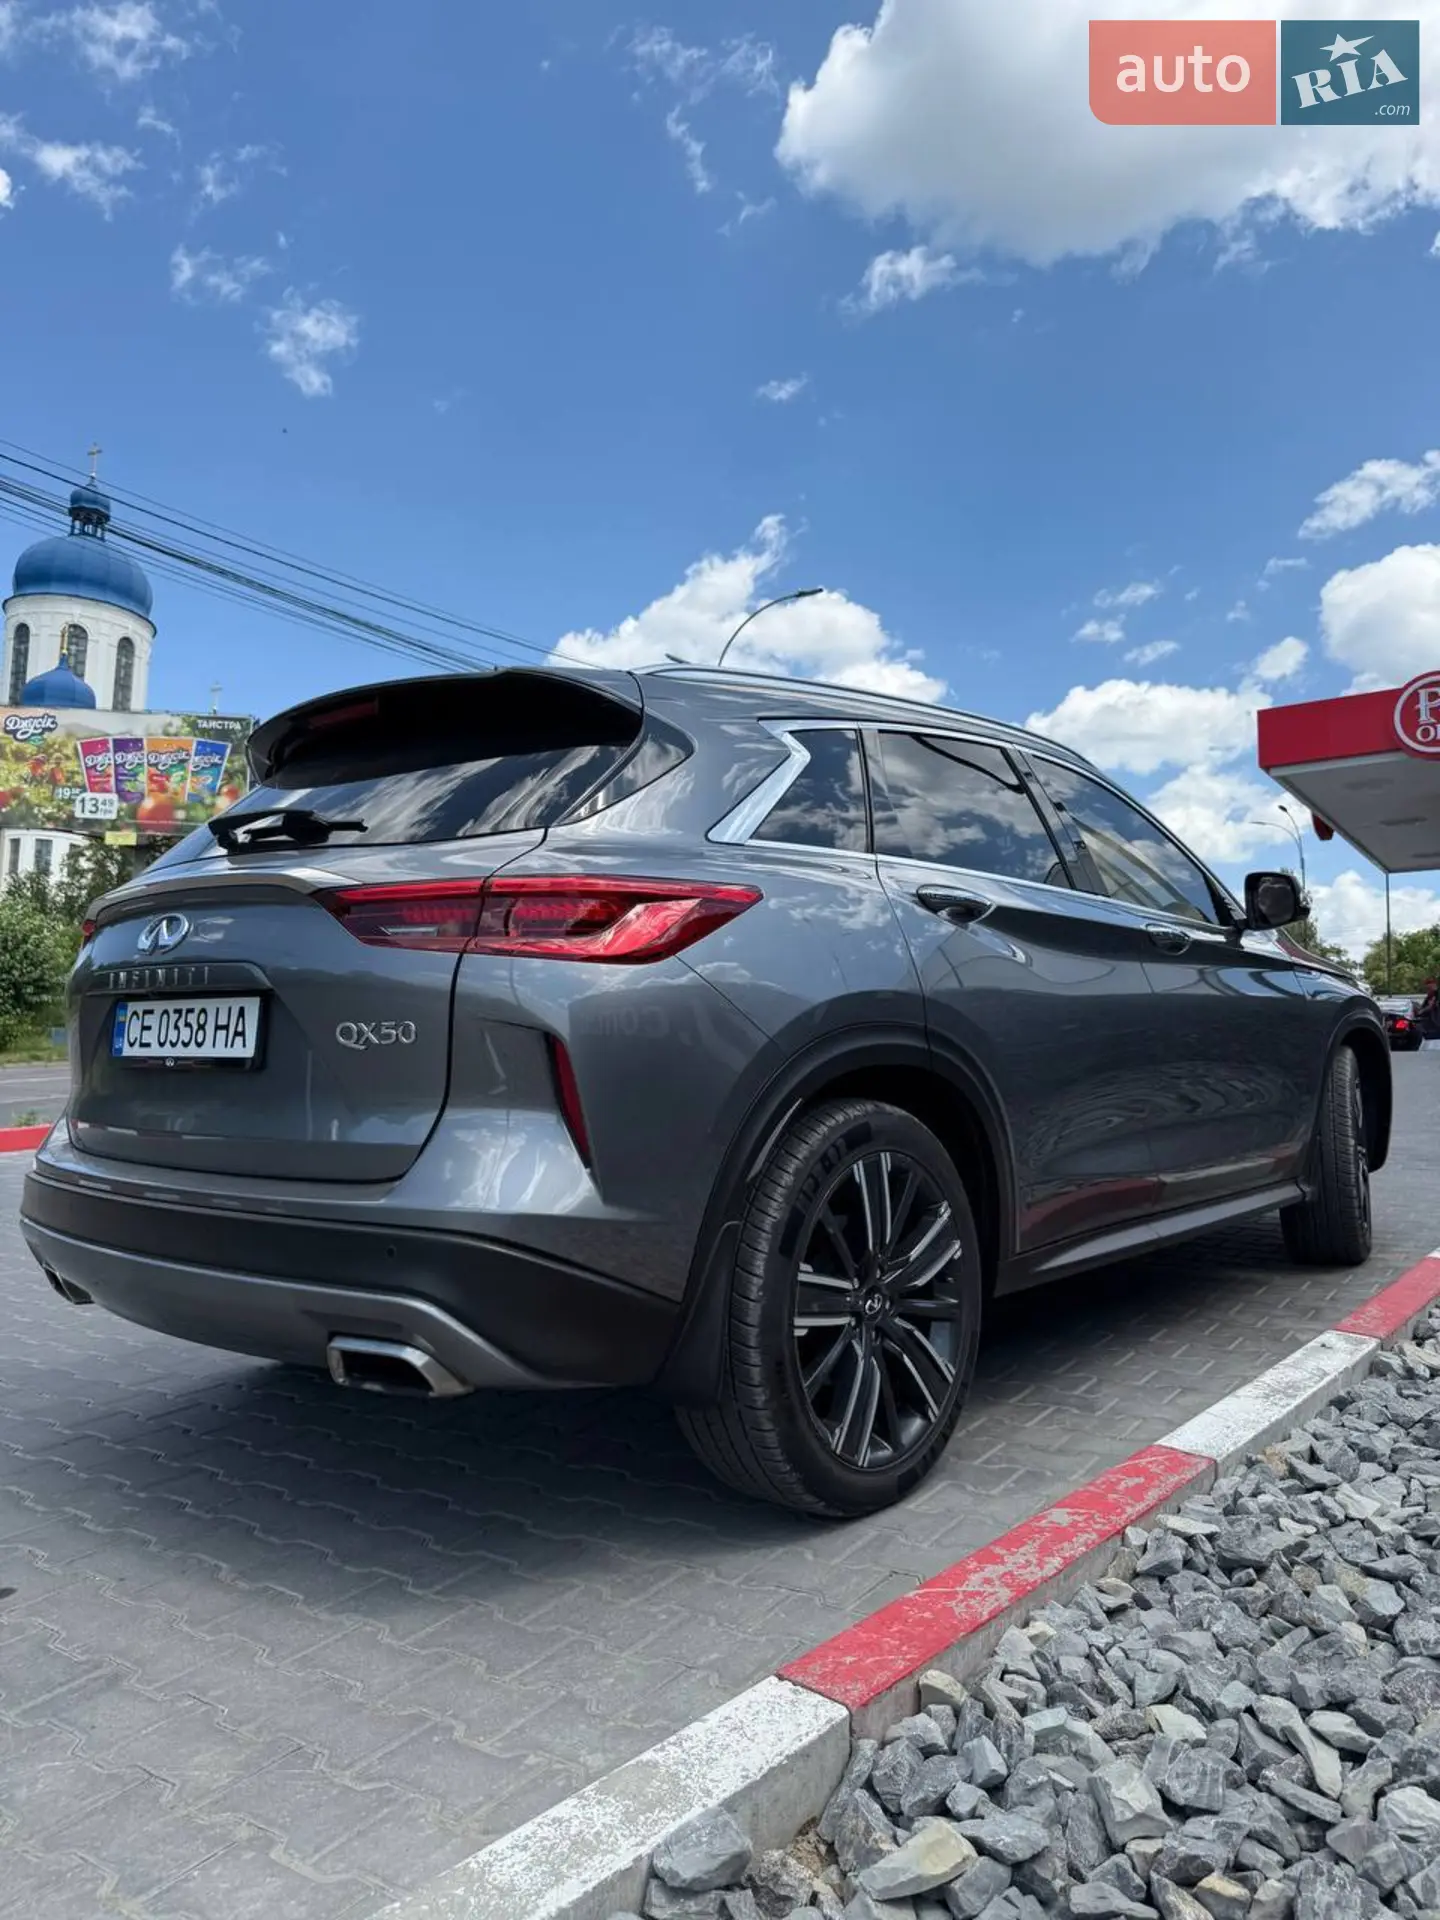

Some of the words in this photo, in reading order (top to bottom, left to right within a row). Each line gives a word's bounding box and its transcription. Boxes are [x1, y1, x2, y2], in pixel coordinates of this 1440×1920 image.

[5, 715, 57, 740] Джусік
[80, 797, 99, 814] 13
[109, 966, 209, 989] INFINITI
[127, 1009, 155, 1048] CE
[157, 1007, 208, 1049] 0358
[212, 1006, 247, 1049] HA
[336, 1020, 416, 1050] QX50
